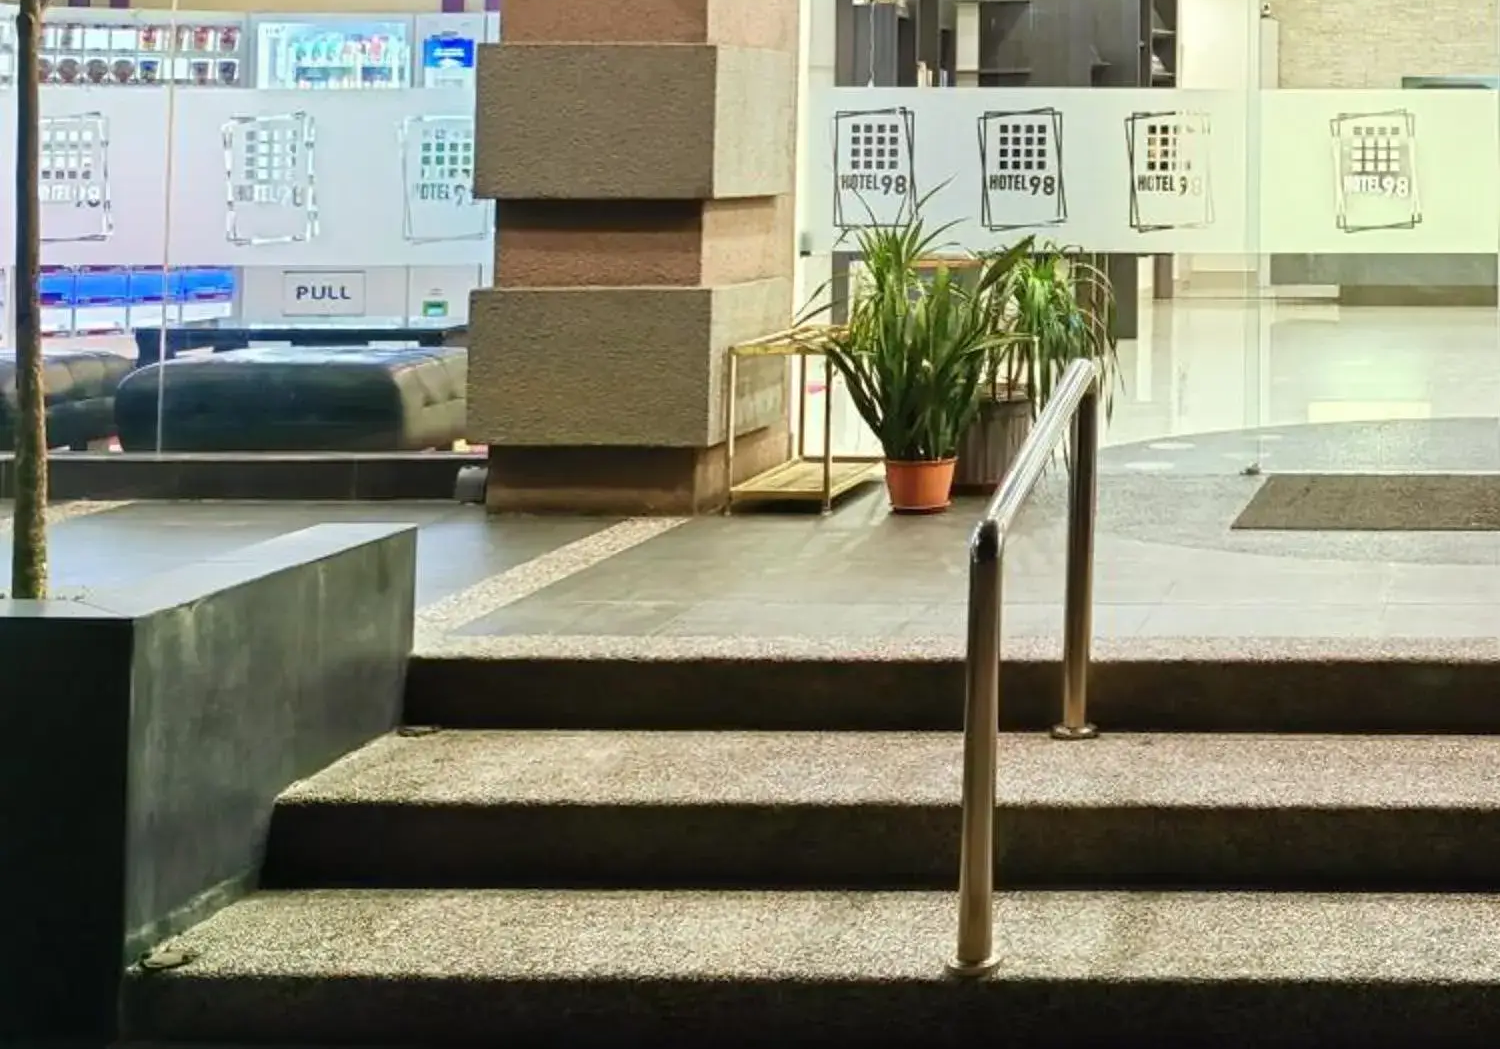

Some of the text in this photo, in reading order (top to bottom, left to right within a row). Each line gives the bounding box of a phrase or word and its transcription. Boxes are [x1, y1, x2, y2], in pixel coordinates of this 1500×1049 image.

[841, 173, 907, 195] HOTEL 98
[989, 174, 1055, 196] HOTEL 98
[1137, 174, 1176, 192] HOTEL
[1343, 175, 1409, 198] HOTEL 98
[295, 284, 352, 301] PULL
